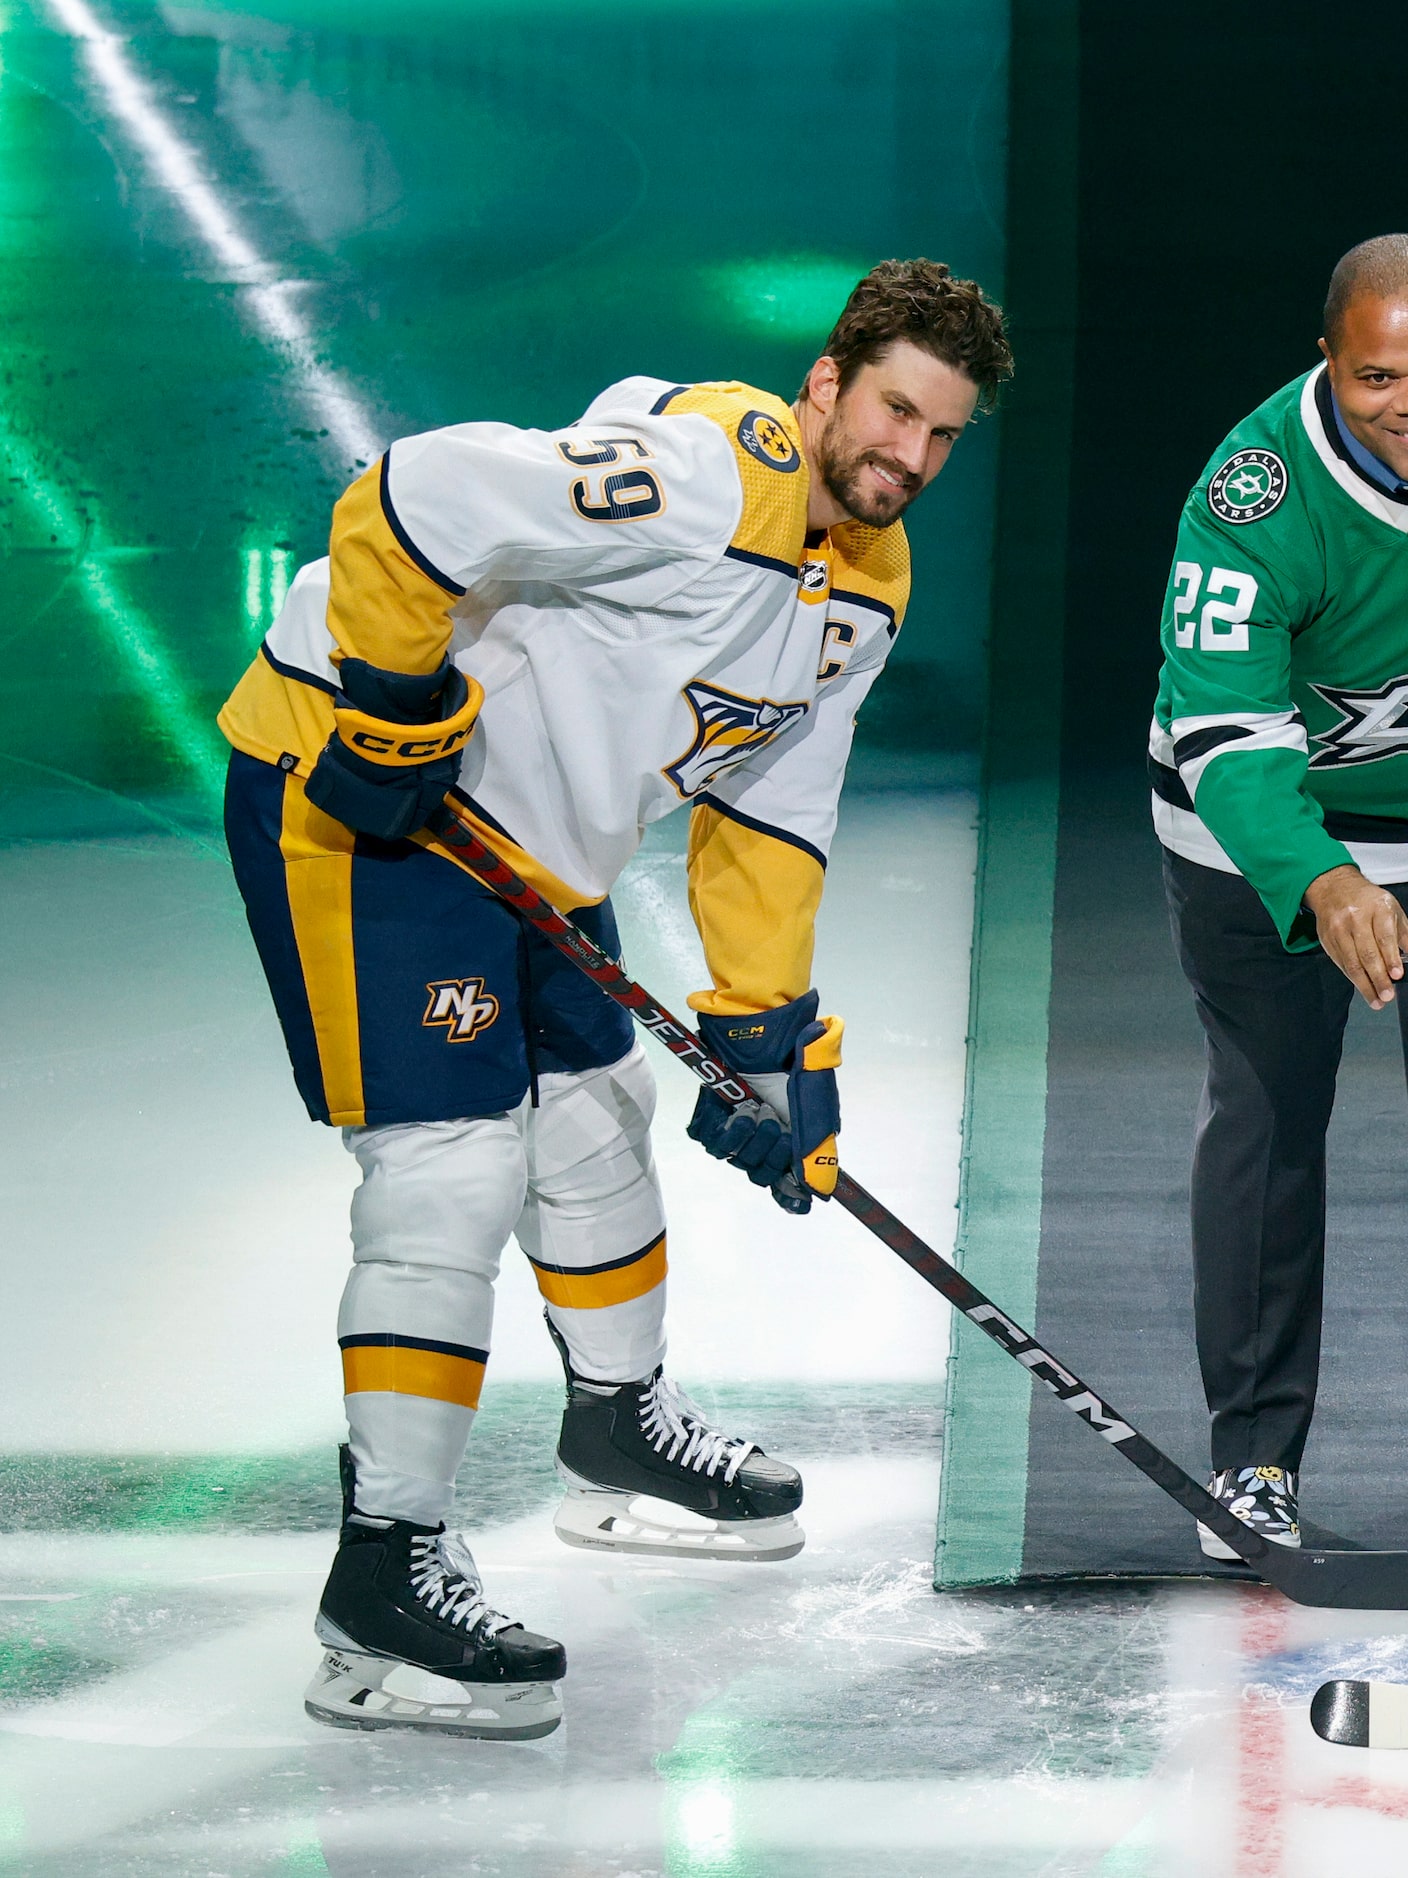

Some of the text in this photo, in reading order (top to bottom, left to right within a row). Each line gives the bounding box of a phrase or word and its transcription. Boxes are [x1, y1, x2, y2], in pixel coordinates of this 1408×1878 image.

[555, 437, 667, 524] 59
[1213, 478, 1255, 518] STARS
[1232, 452, 1282, 501] DALLAS
[1174, 561, 1258, 651] 22
[816, 618, 858, 684] C
[426, 981, 497, 1039] NP
[629, 1003, 750, 1111] JETSP
[814, 1156, 839, 1166] CC
[965, 1304, 1137, 1444] CCM
